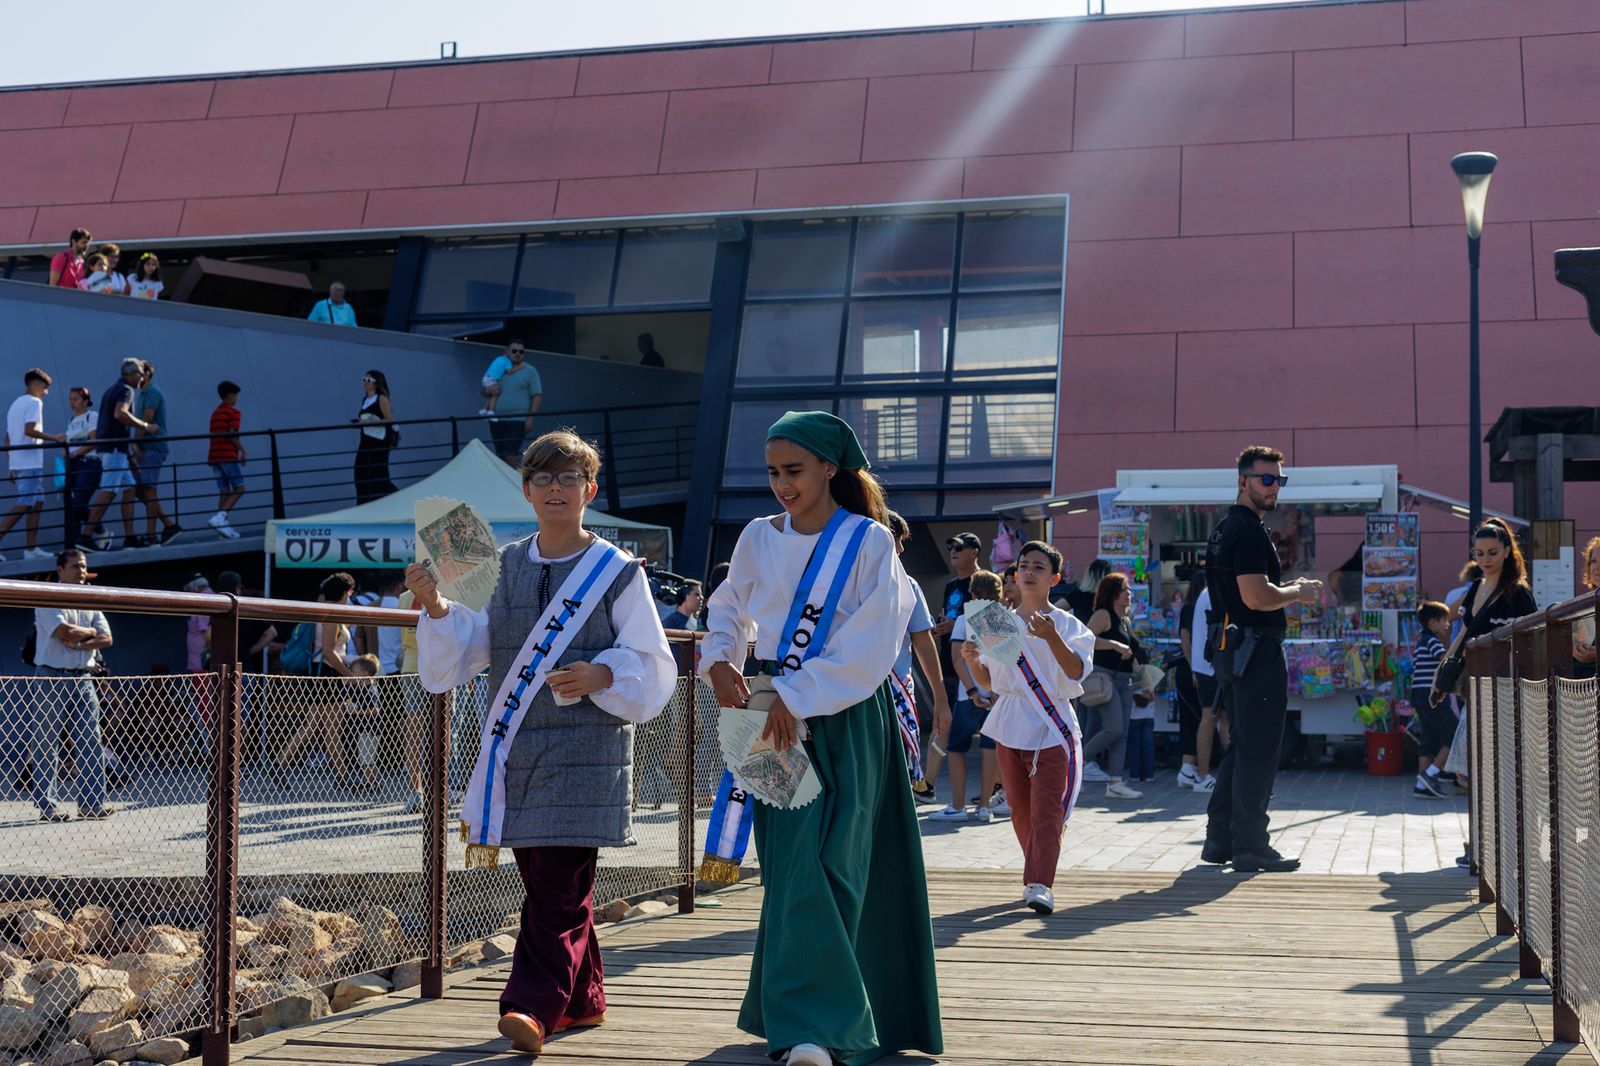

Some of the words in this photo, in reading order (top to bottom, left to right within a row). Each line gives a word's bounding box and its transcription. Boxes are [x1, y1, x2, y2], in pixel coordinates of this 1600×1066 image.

[285, 527, 332, 537] cerveza
[285, 538, 403, 563] ODIEL
[491, 598, 582, 741] HUELVA
